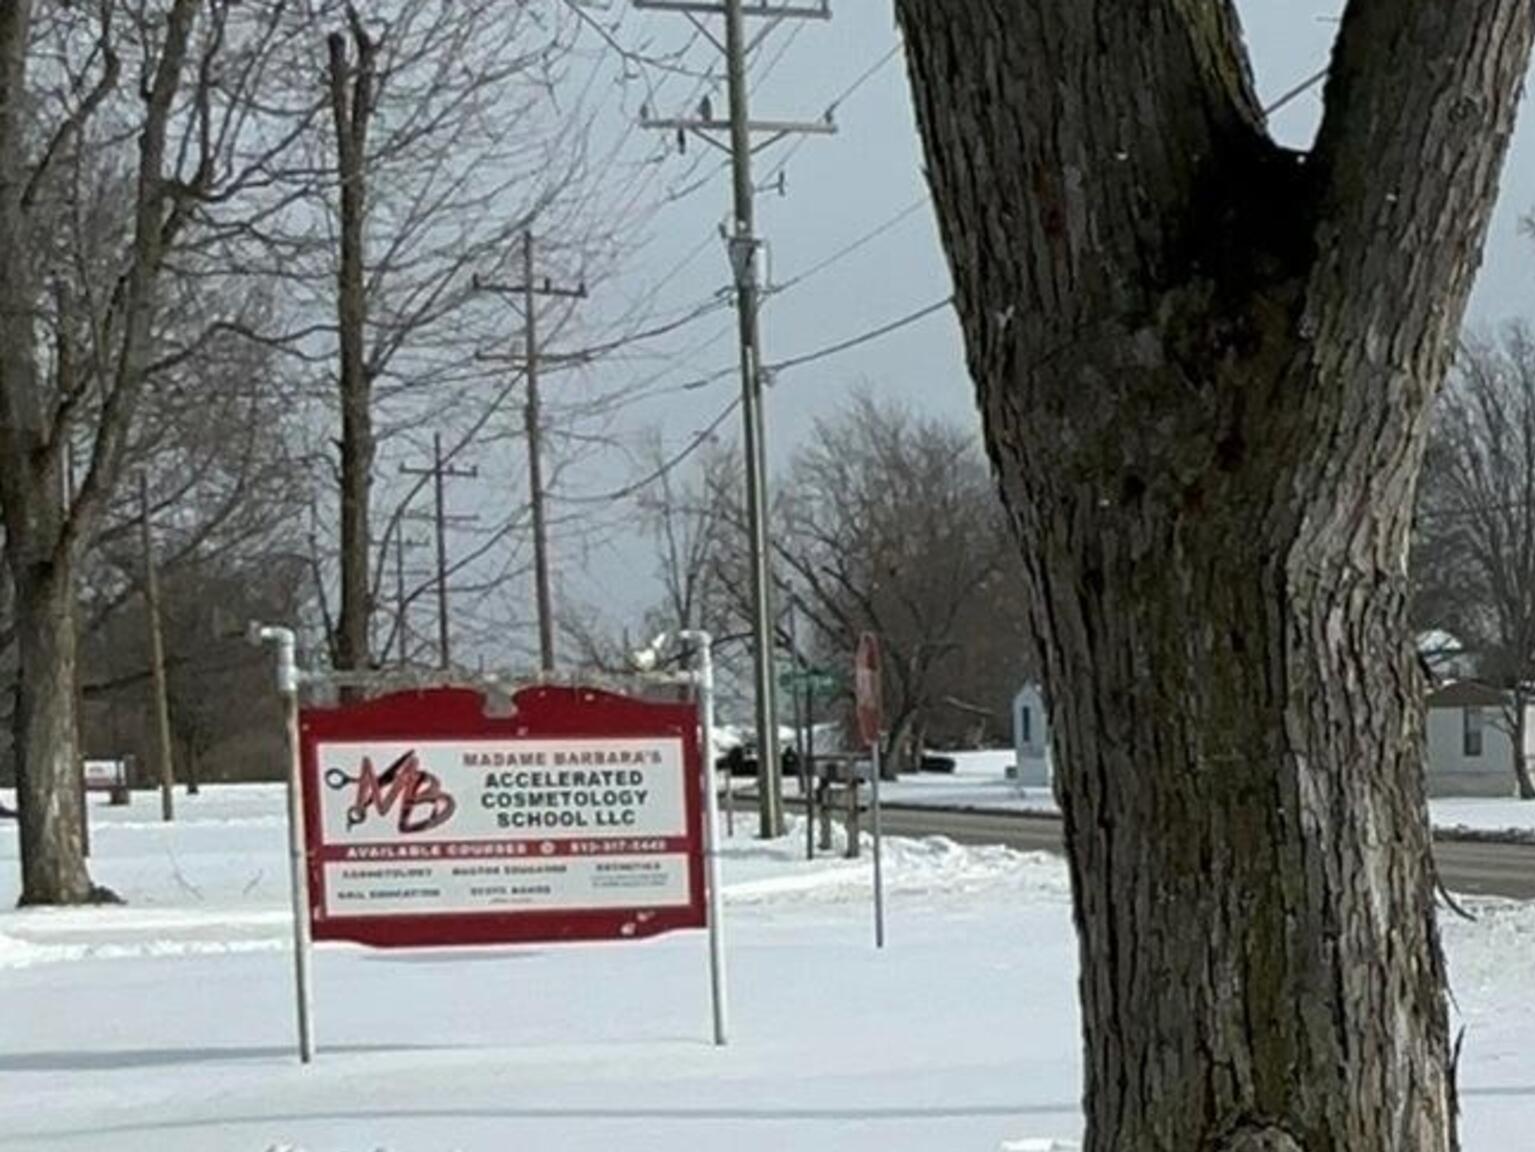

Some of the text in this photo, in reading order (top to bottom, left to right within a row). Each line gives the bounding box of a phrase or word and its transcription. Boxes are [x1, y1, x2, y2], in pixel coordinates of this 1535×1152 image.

[463, 751, 662, 766] MADAME BARBARA'S
[485, 770, 643, 787] ACCELERATED
[481, 790, 648, 808] COSMETOLOGY
[497, 810, 635, 827] SCHOOL LLC
[347, 844, 440, 858] AVAILABLE
[447, 843, 527, 856] COURSES
